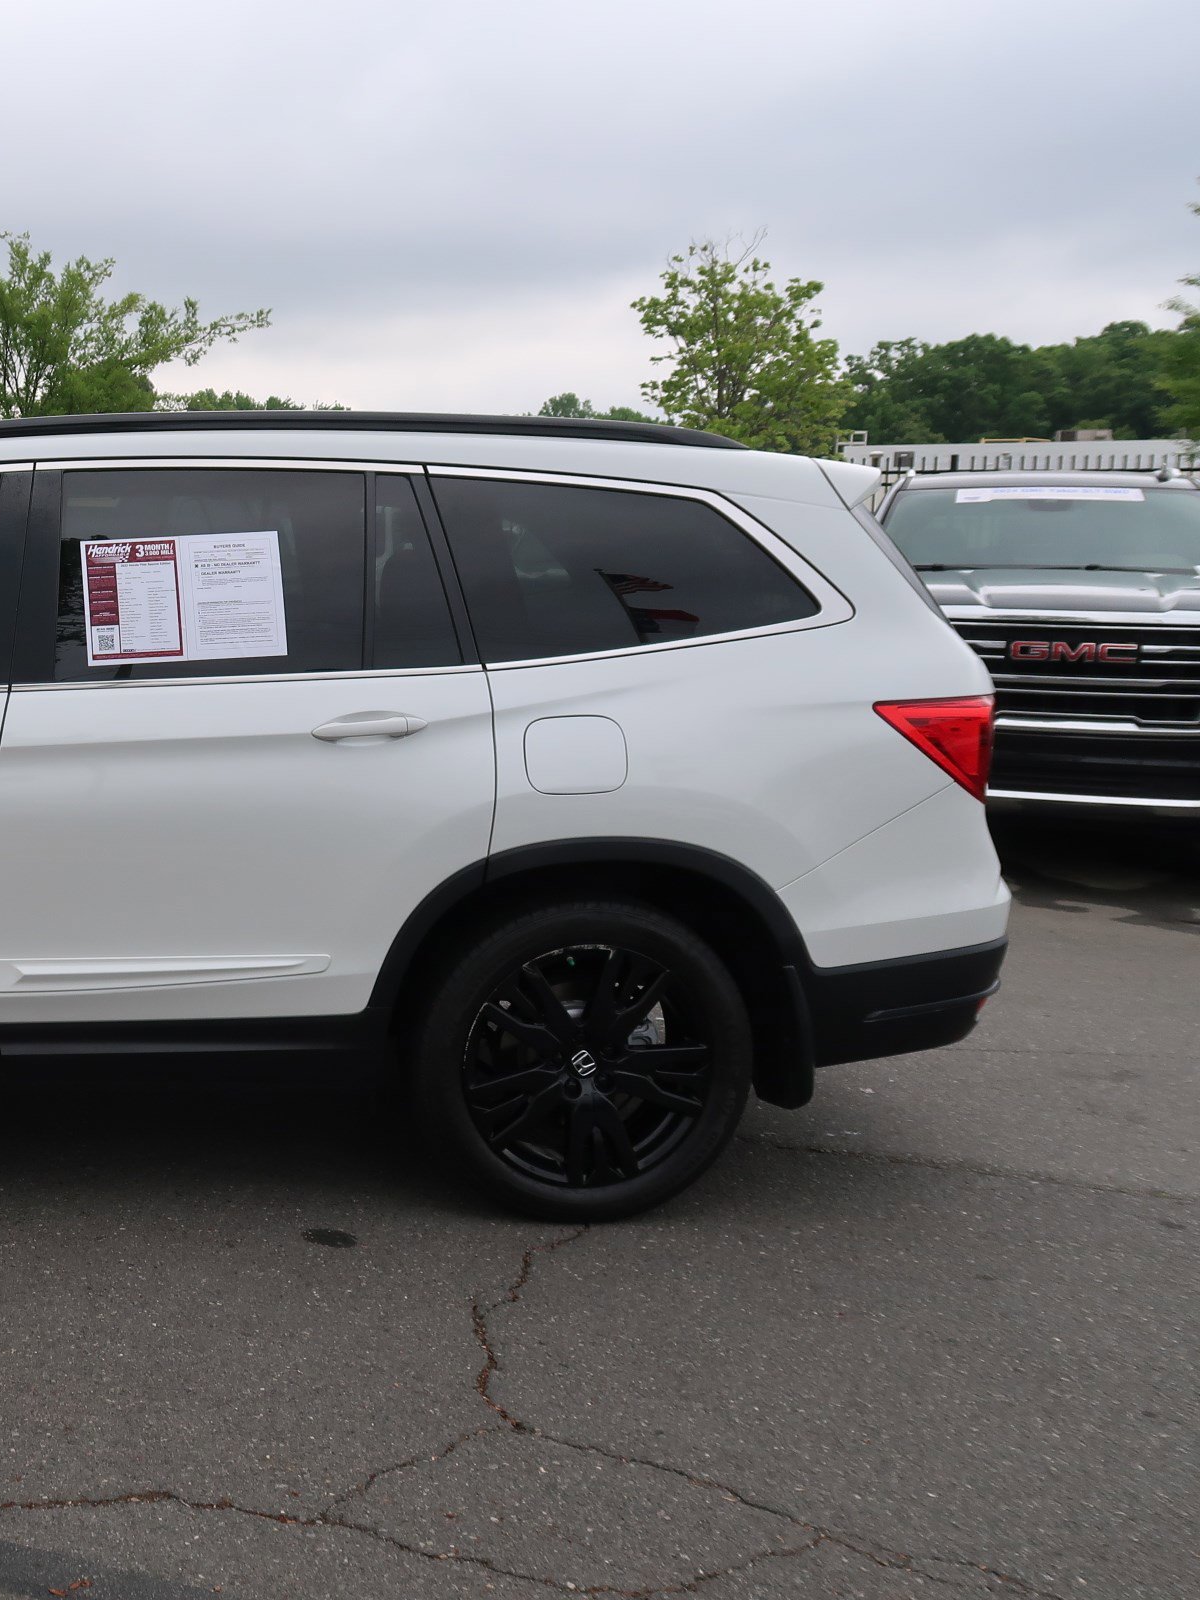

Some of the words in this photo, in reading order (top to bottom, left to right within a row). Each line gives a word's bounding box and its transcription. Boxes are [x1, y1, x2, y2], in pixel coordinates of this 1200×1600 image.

[87, 543, 131, 557] Hendrick
[135, 544, 145, 558] 3
[1010, 640, 1139, 664] GMC
